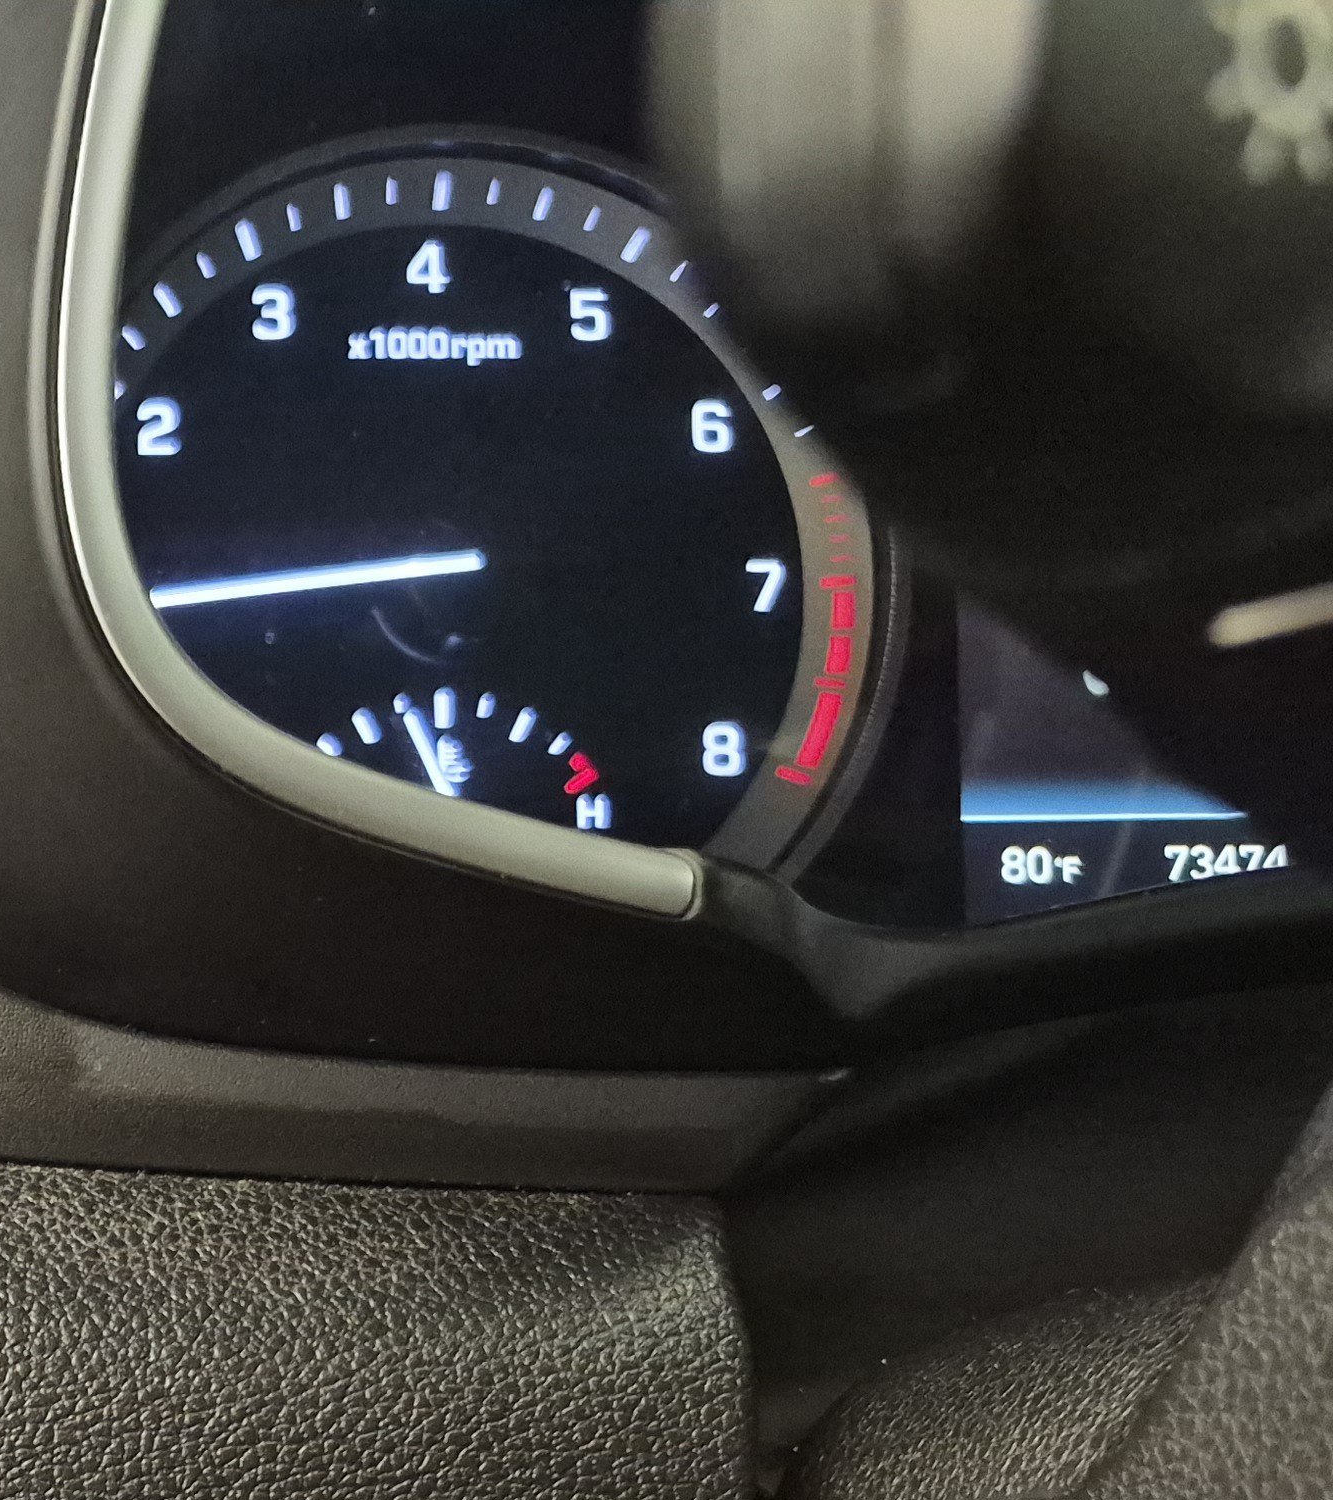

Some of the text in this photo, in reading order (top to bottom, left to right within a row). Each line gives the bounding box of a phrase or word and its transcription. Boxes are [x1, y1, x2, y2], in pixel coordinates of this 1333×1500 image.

[406, 240, 450, 293] 4
[251, 283, 297, 341] 3
[566, 287, 612, 342] 5
[347, 326, 522, 366] x1000rpm
[136, 396, 181, 456] 2
[691, 400, 734, 454] 6
[745, 558, 787, 613] 7
[702, 720, 746, 777] 8
[575, 793, 612, 830] H
